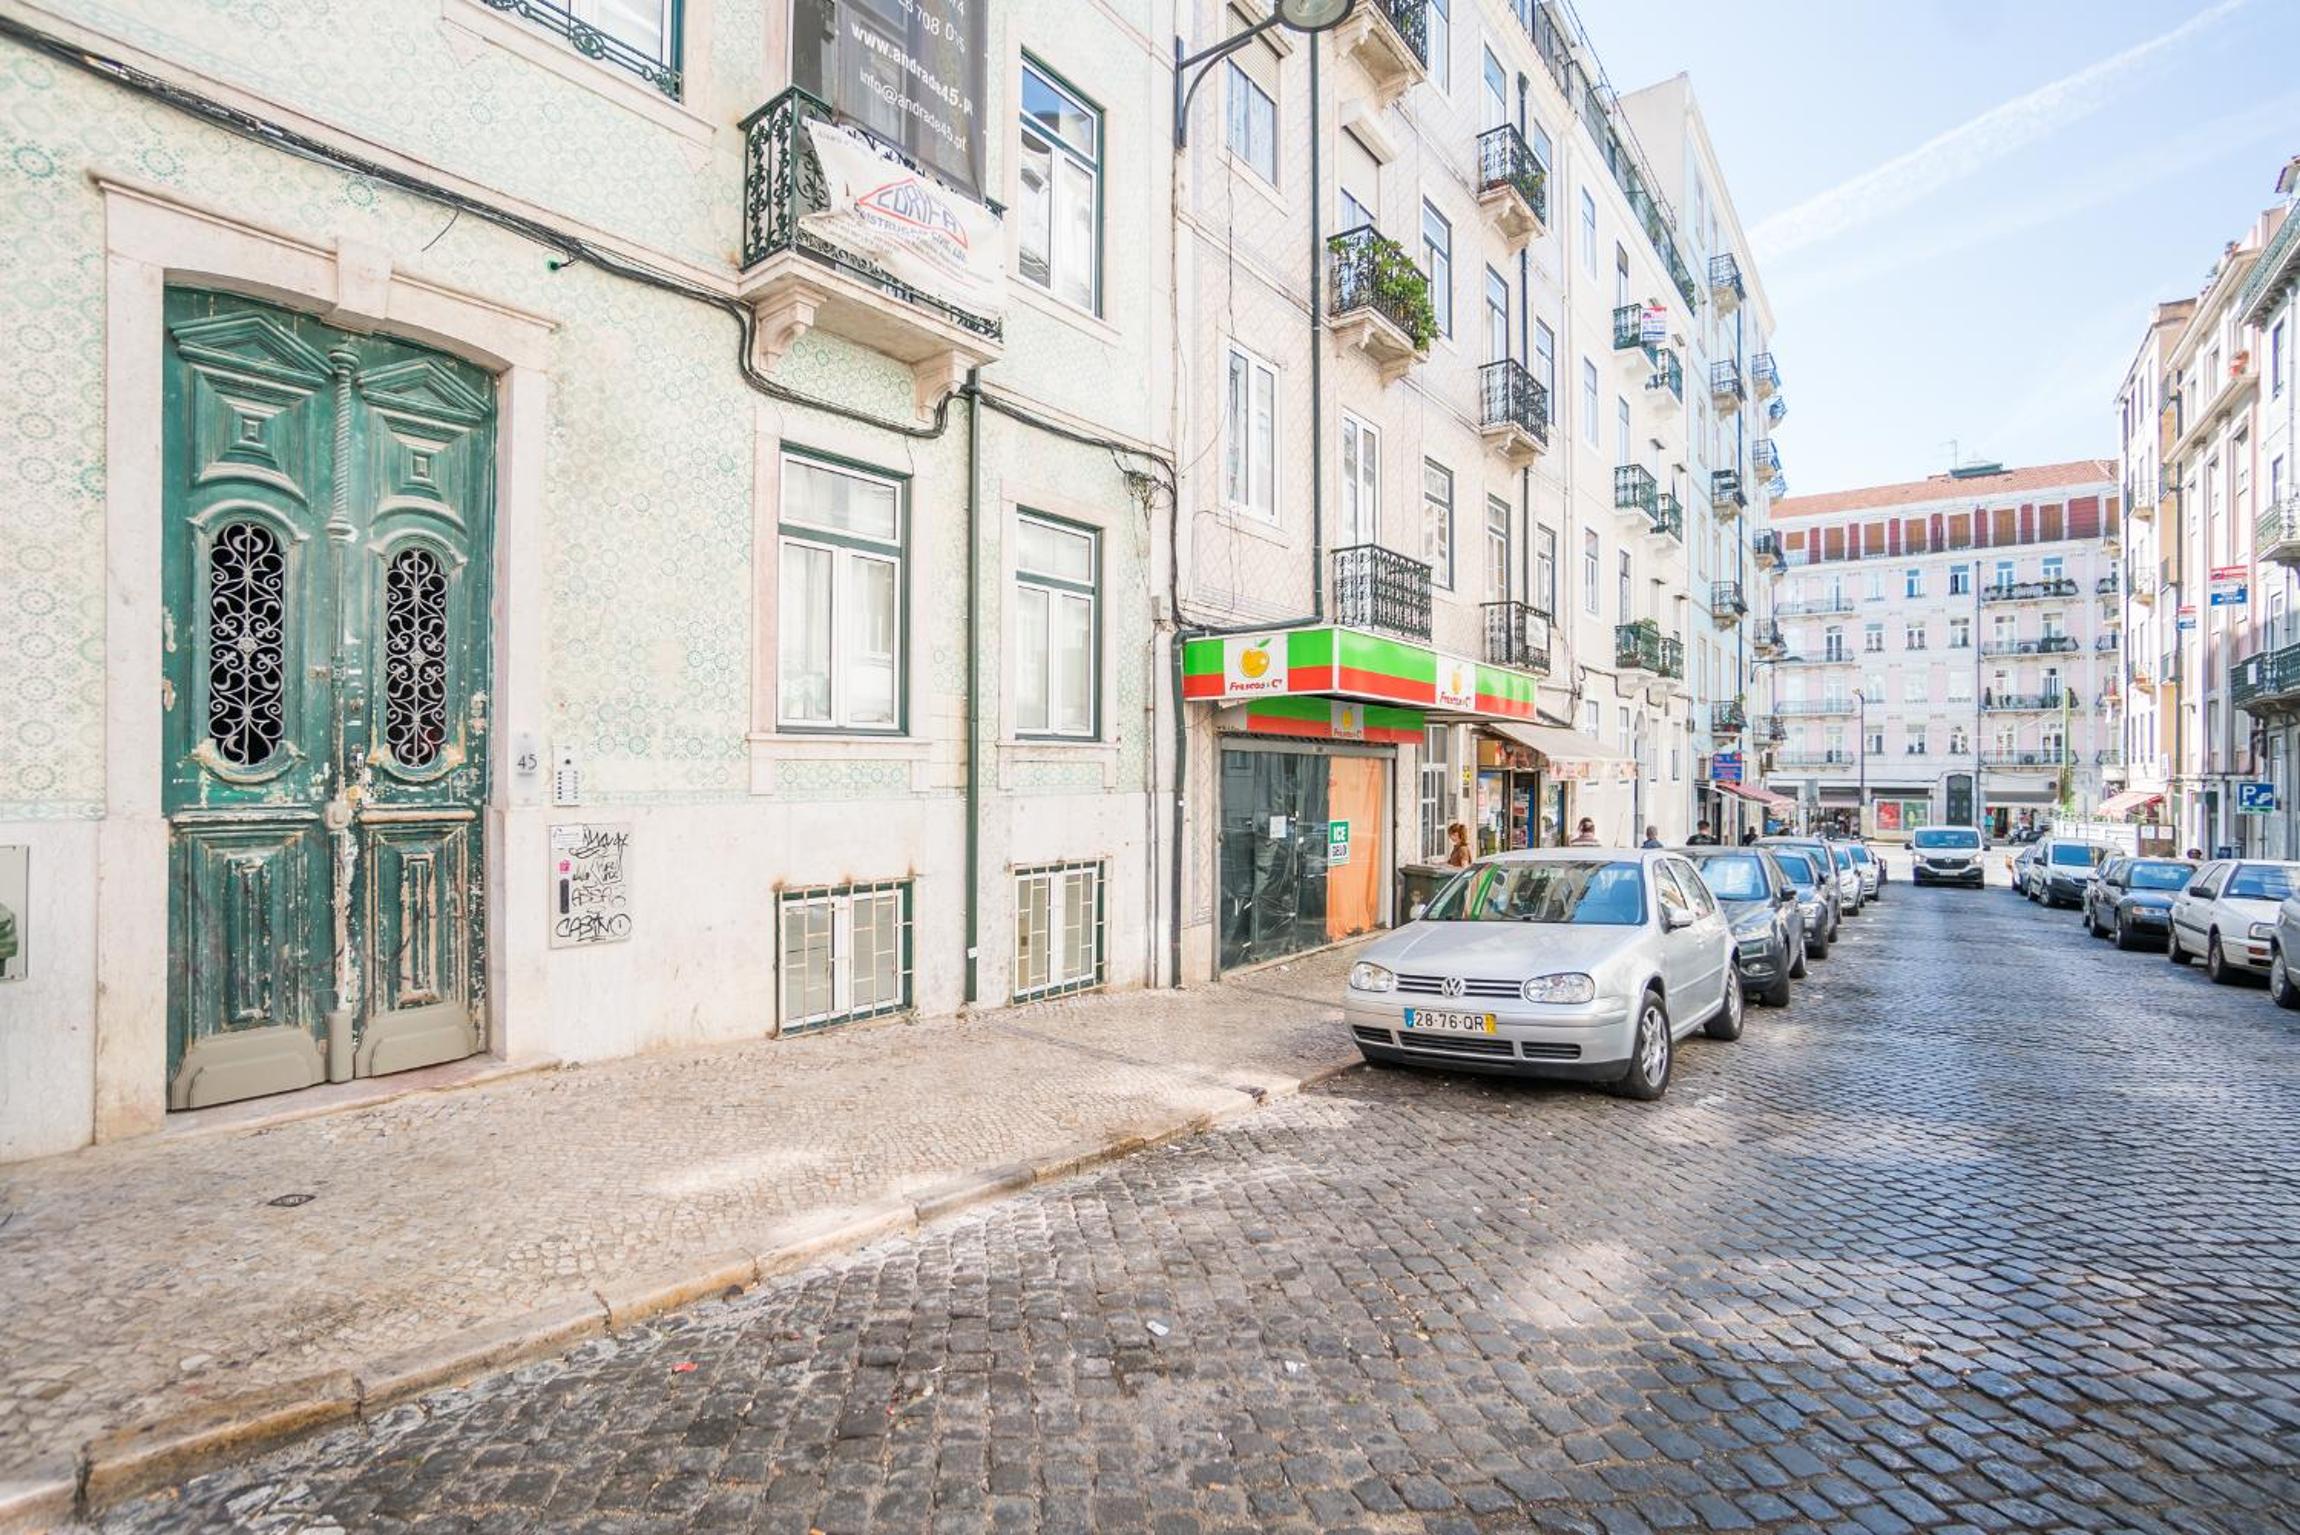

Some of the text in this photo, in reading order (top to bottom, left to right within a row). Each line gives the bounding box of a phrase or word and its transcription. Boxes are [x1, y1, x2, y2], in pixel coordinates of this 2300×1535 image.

[916, 4, 940, 35] 708
[517, 754, 537, 770] 45
[2243, 786, 2257, 800] P
[1333, 826, 1346, 841] ICE
